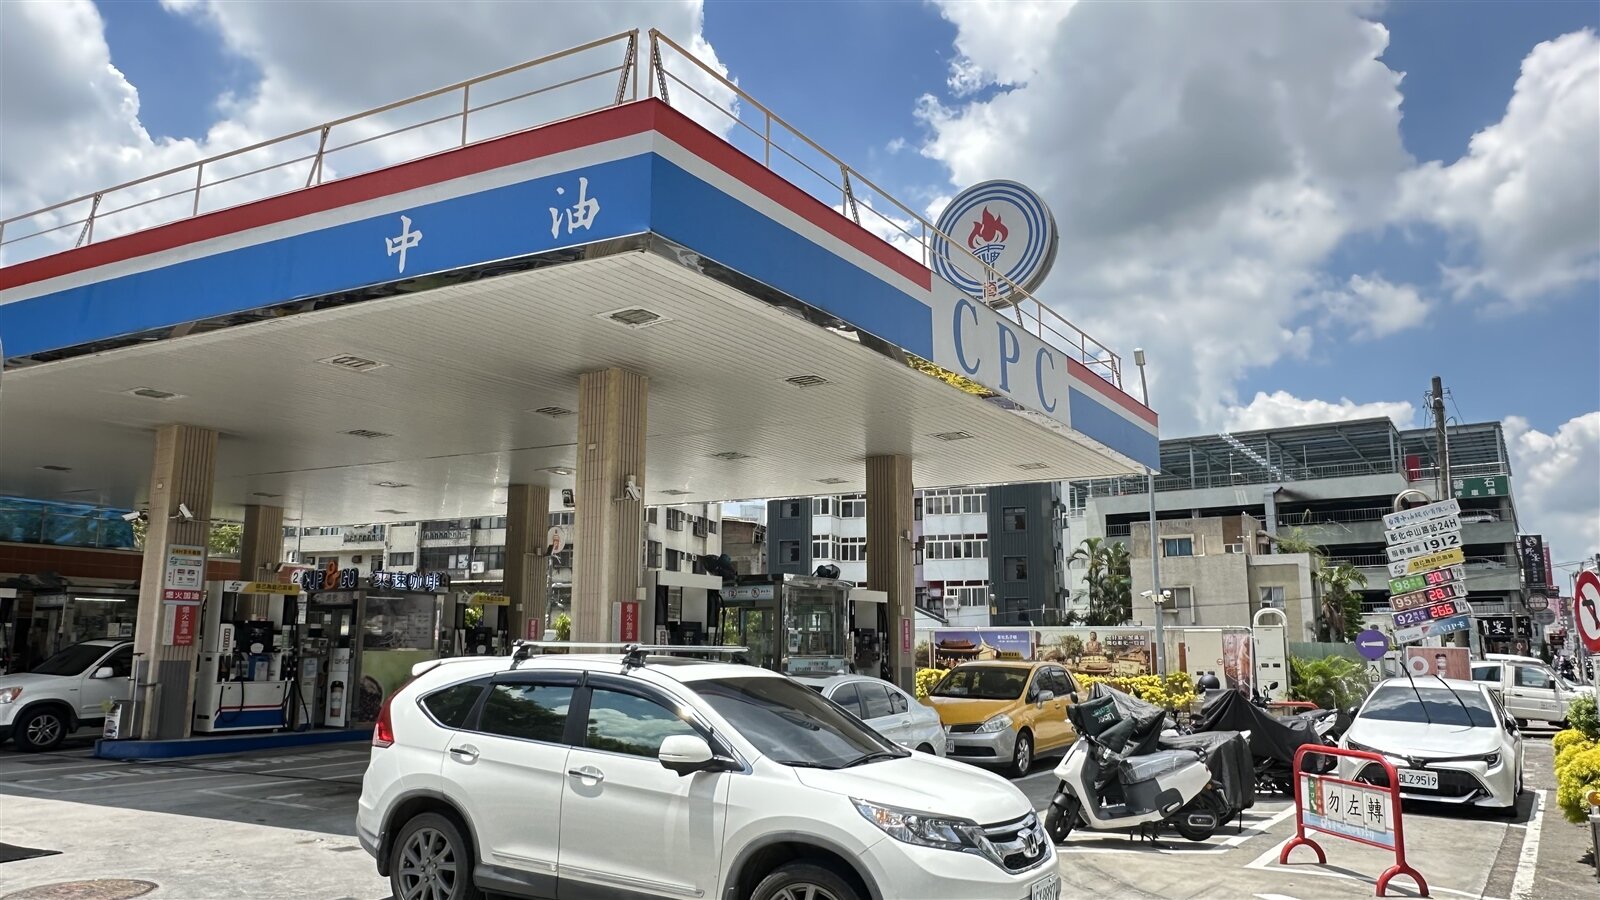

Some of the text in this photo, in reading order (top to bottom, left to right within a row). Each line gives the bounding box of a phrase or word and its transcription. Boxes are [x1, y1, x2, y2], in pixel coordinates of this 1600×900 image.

[953, 298, 1057, 413] CPC
[1423, 535, 1459, 550] 1912
[1394, 580, 1411, 591] 98
[165, 590, 200, 600] 熄火加油
[1395, 596, 1413, 608] 95
[1397, 613, 1415, 625] 92
[1398, 773, 1437, 787] BLZ-9519
[1328, 790, 1384, 824] 勿左轉
